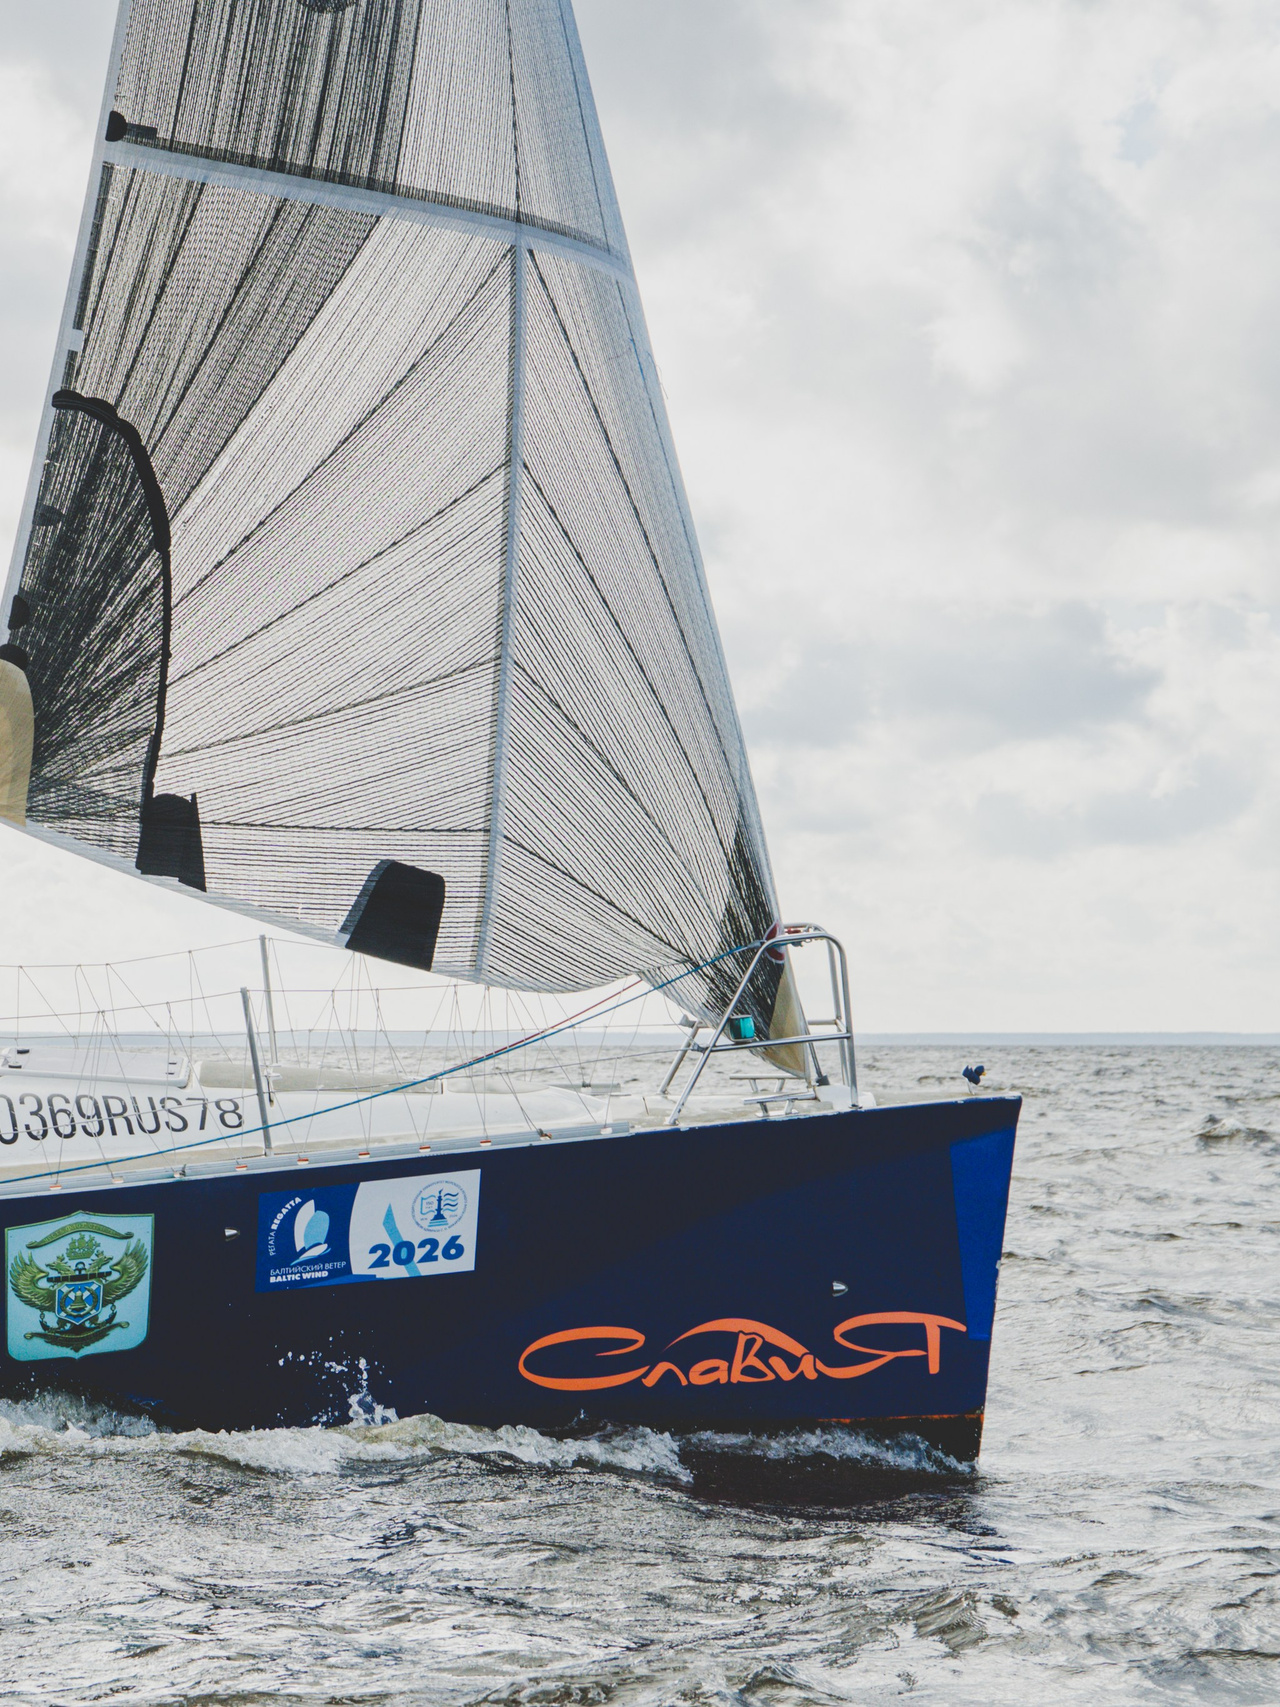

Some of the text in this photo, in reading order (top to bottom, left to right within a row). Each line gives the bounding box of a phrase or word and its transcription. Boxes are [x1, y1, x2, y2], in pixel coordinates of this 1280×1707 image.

[271, 1197, 302, 1230] REGATTA
[367, 1235, 465, 1269] 2026
[270, 1261, 346, 1276] БАЛТИЙСКИЙ ВЕТЕР
[270, 1271, 329, 1283] BALTIC WIND
